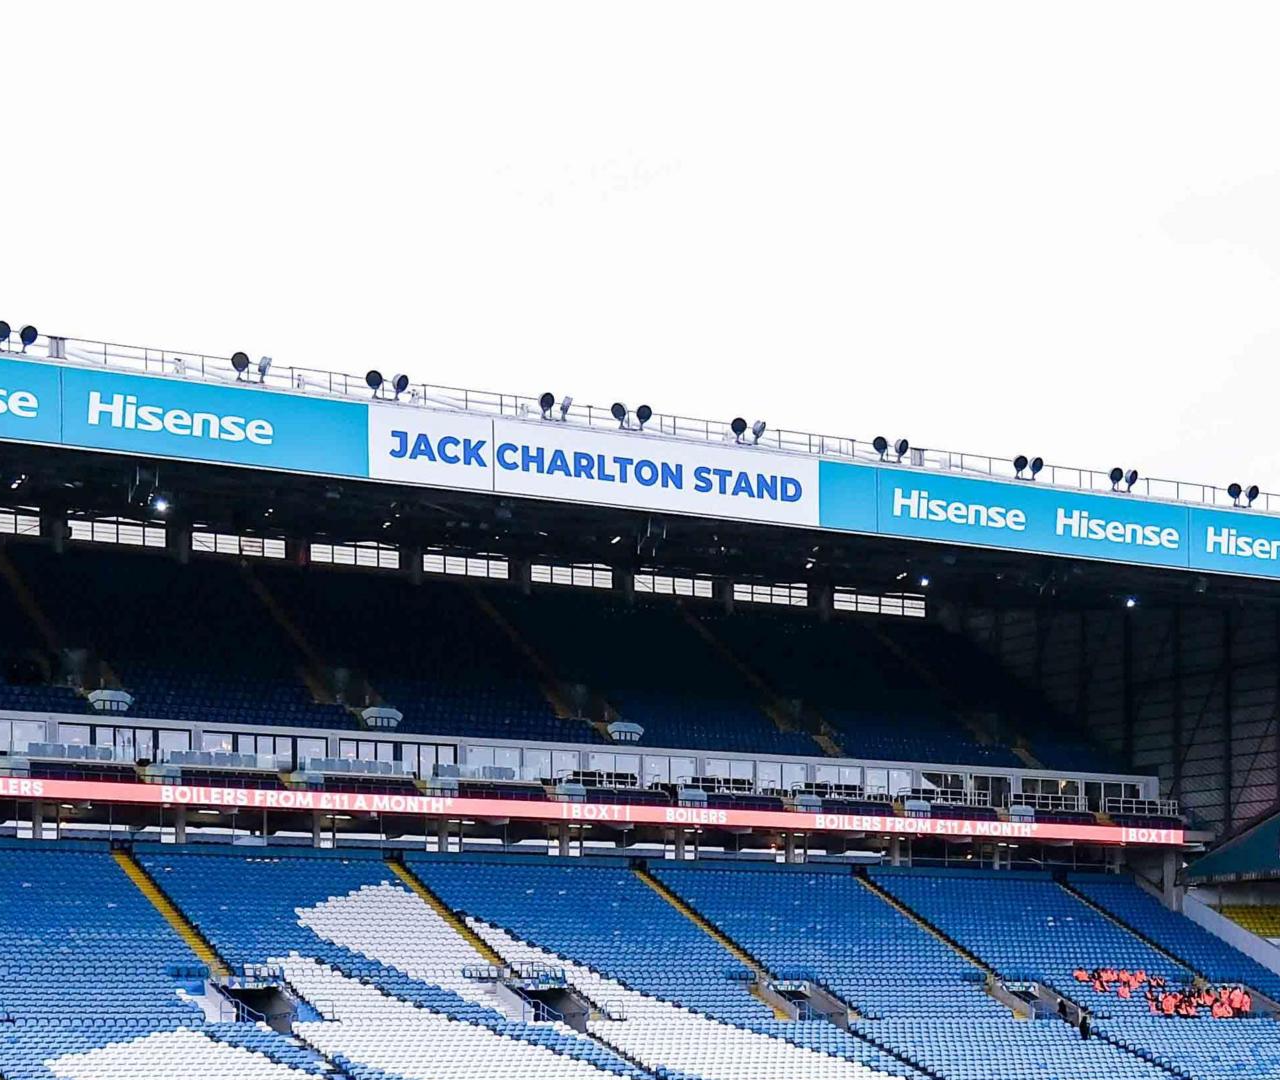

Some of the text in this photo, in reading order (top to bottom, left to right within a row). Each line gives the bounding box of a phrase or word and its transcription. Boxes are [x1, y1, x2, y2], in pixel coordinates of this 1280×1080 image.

[87, 391, 274, 445] Hisense
[389, 430, 803, 502] JACK CHARLTON STAND
[893, 488, 1025, 532] Hisense
[1055, 508, 1179, 548] Hisense
[161, 787, 247, 806] BOILERS
[253, 790, 313, 809] FROM
[320, 791, 349, 810] £11
[353, 793, 368, 810] A
[666, 809, 727, 824] BOILERS
[815, 814, 881, 832] BOILERS
[885, 817, 931, 833] FROM
[935, 819, 958, 834] £11
[961, 820, 975, 835] A
